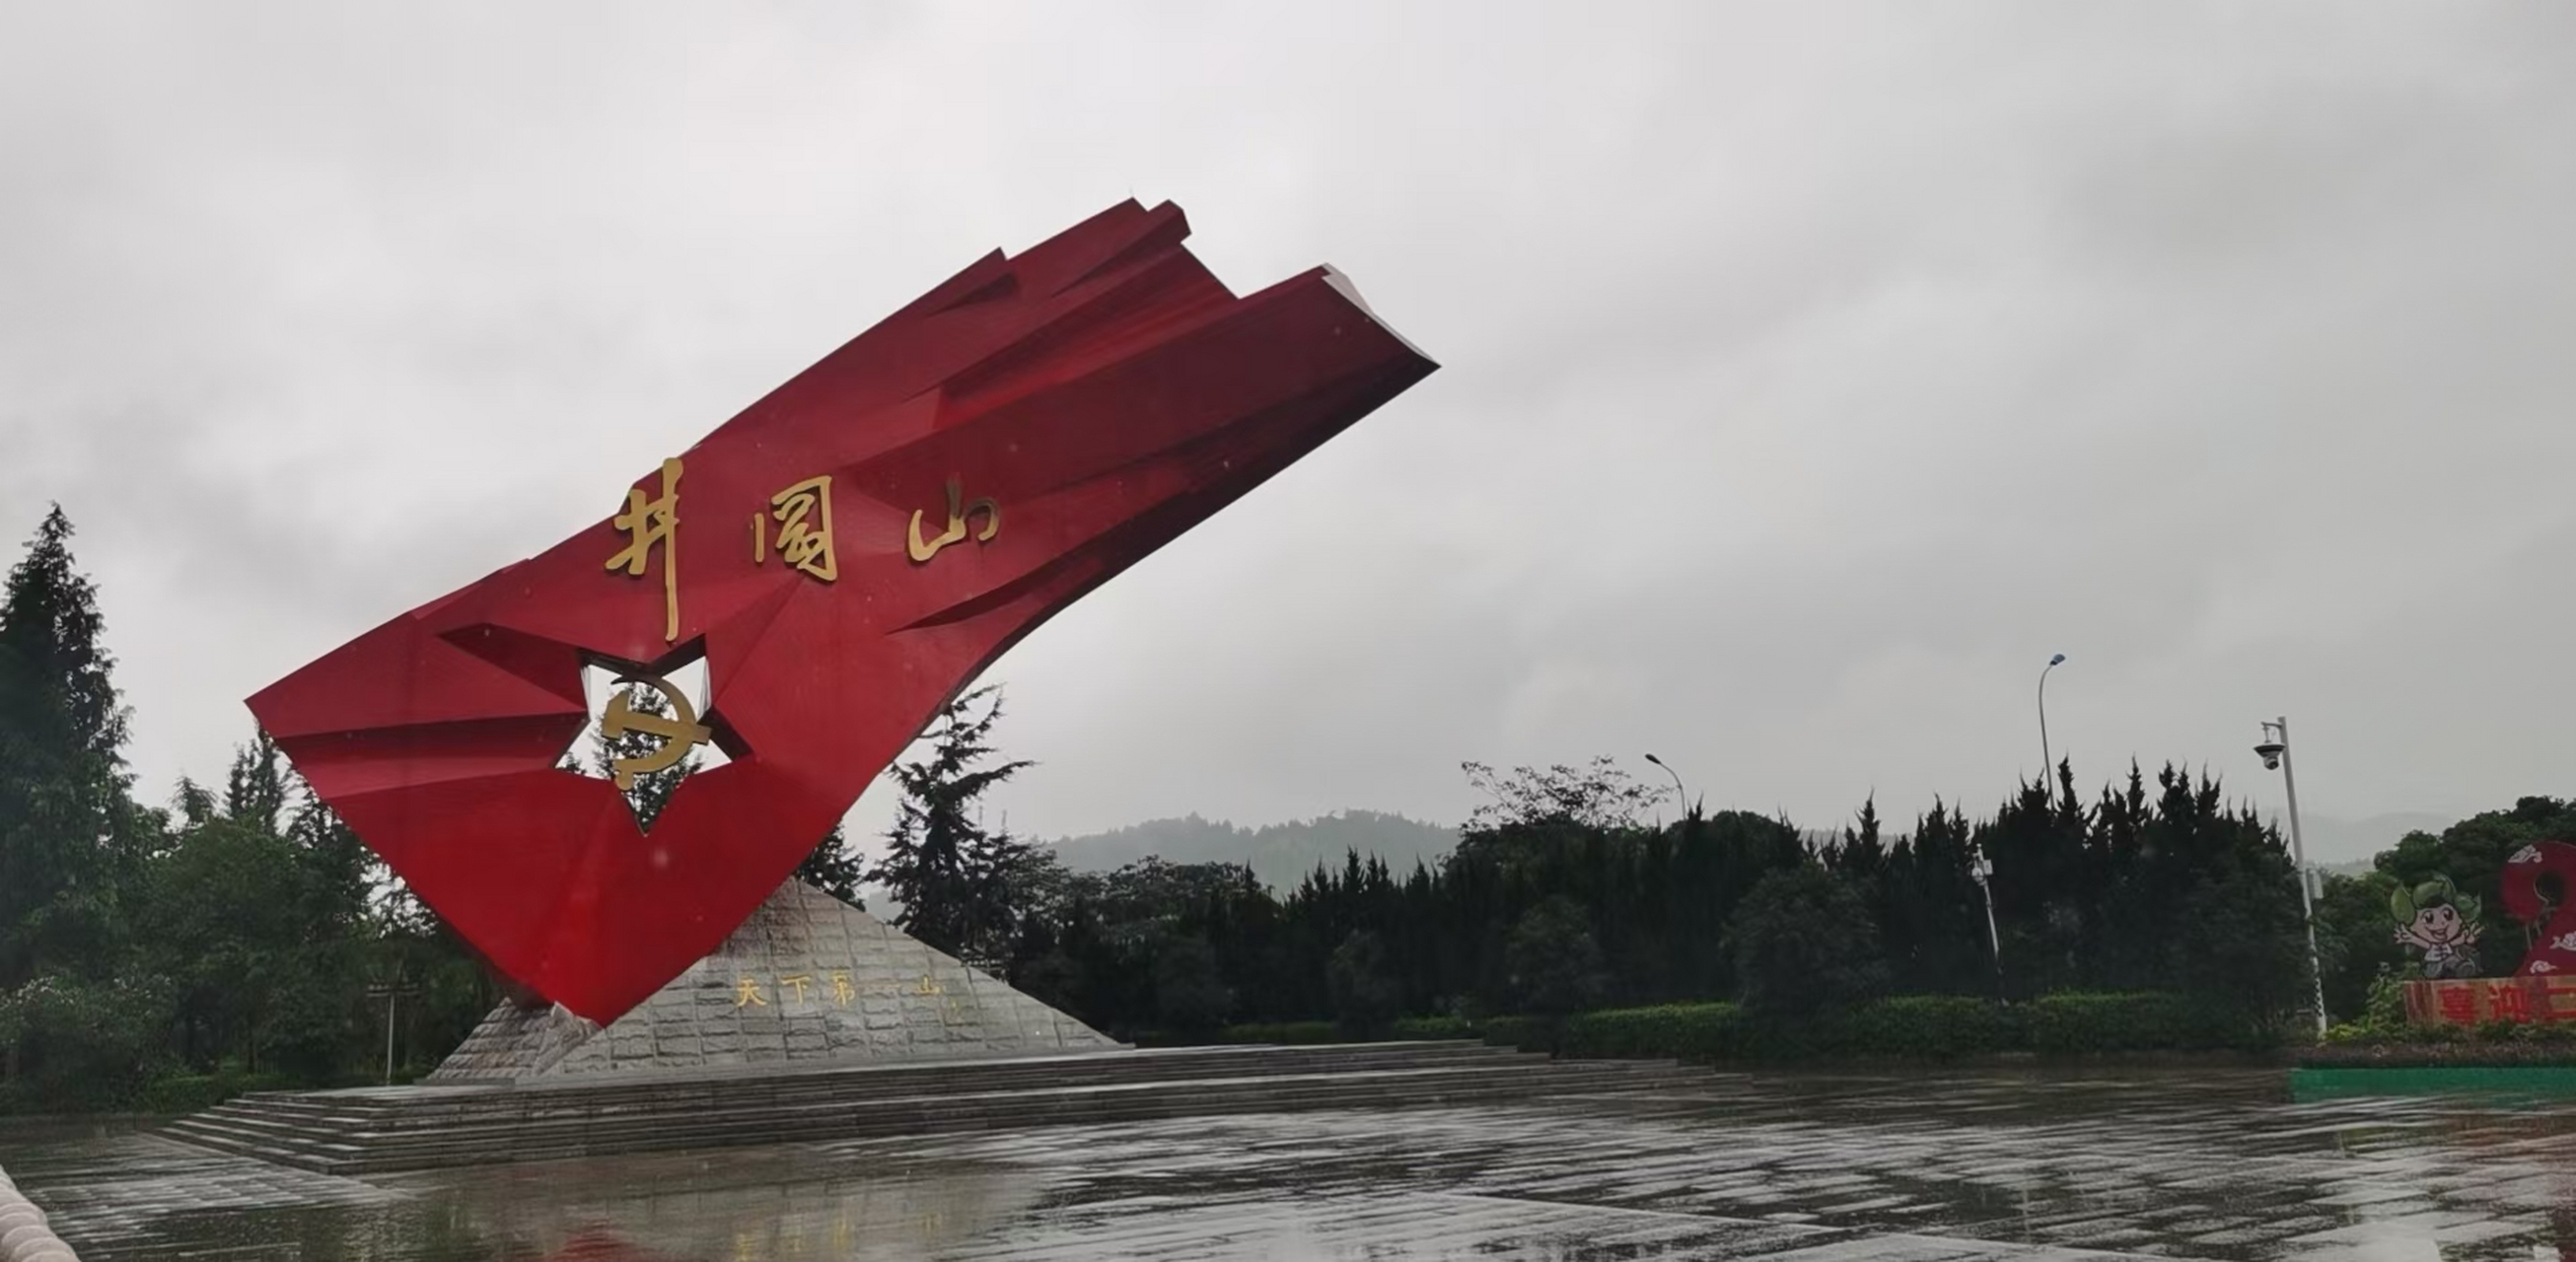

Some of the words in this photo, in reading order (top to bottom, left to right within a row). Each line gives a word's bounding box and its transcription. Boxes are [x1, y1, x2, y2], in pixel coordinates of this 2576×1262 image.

[737, 971, 940, 1008] 天下第一山
